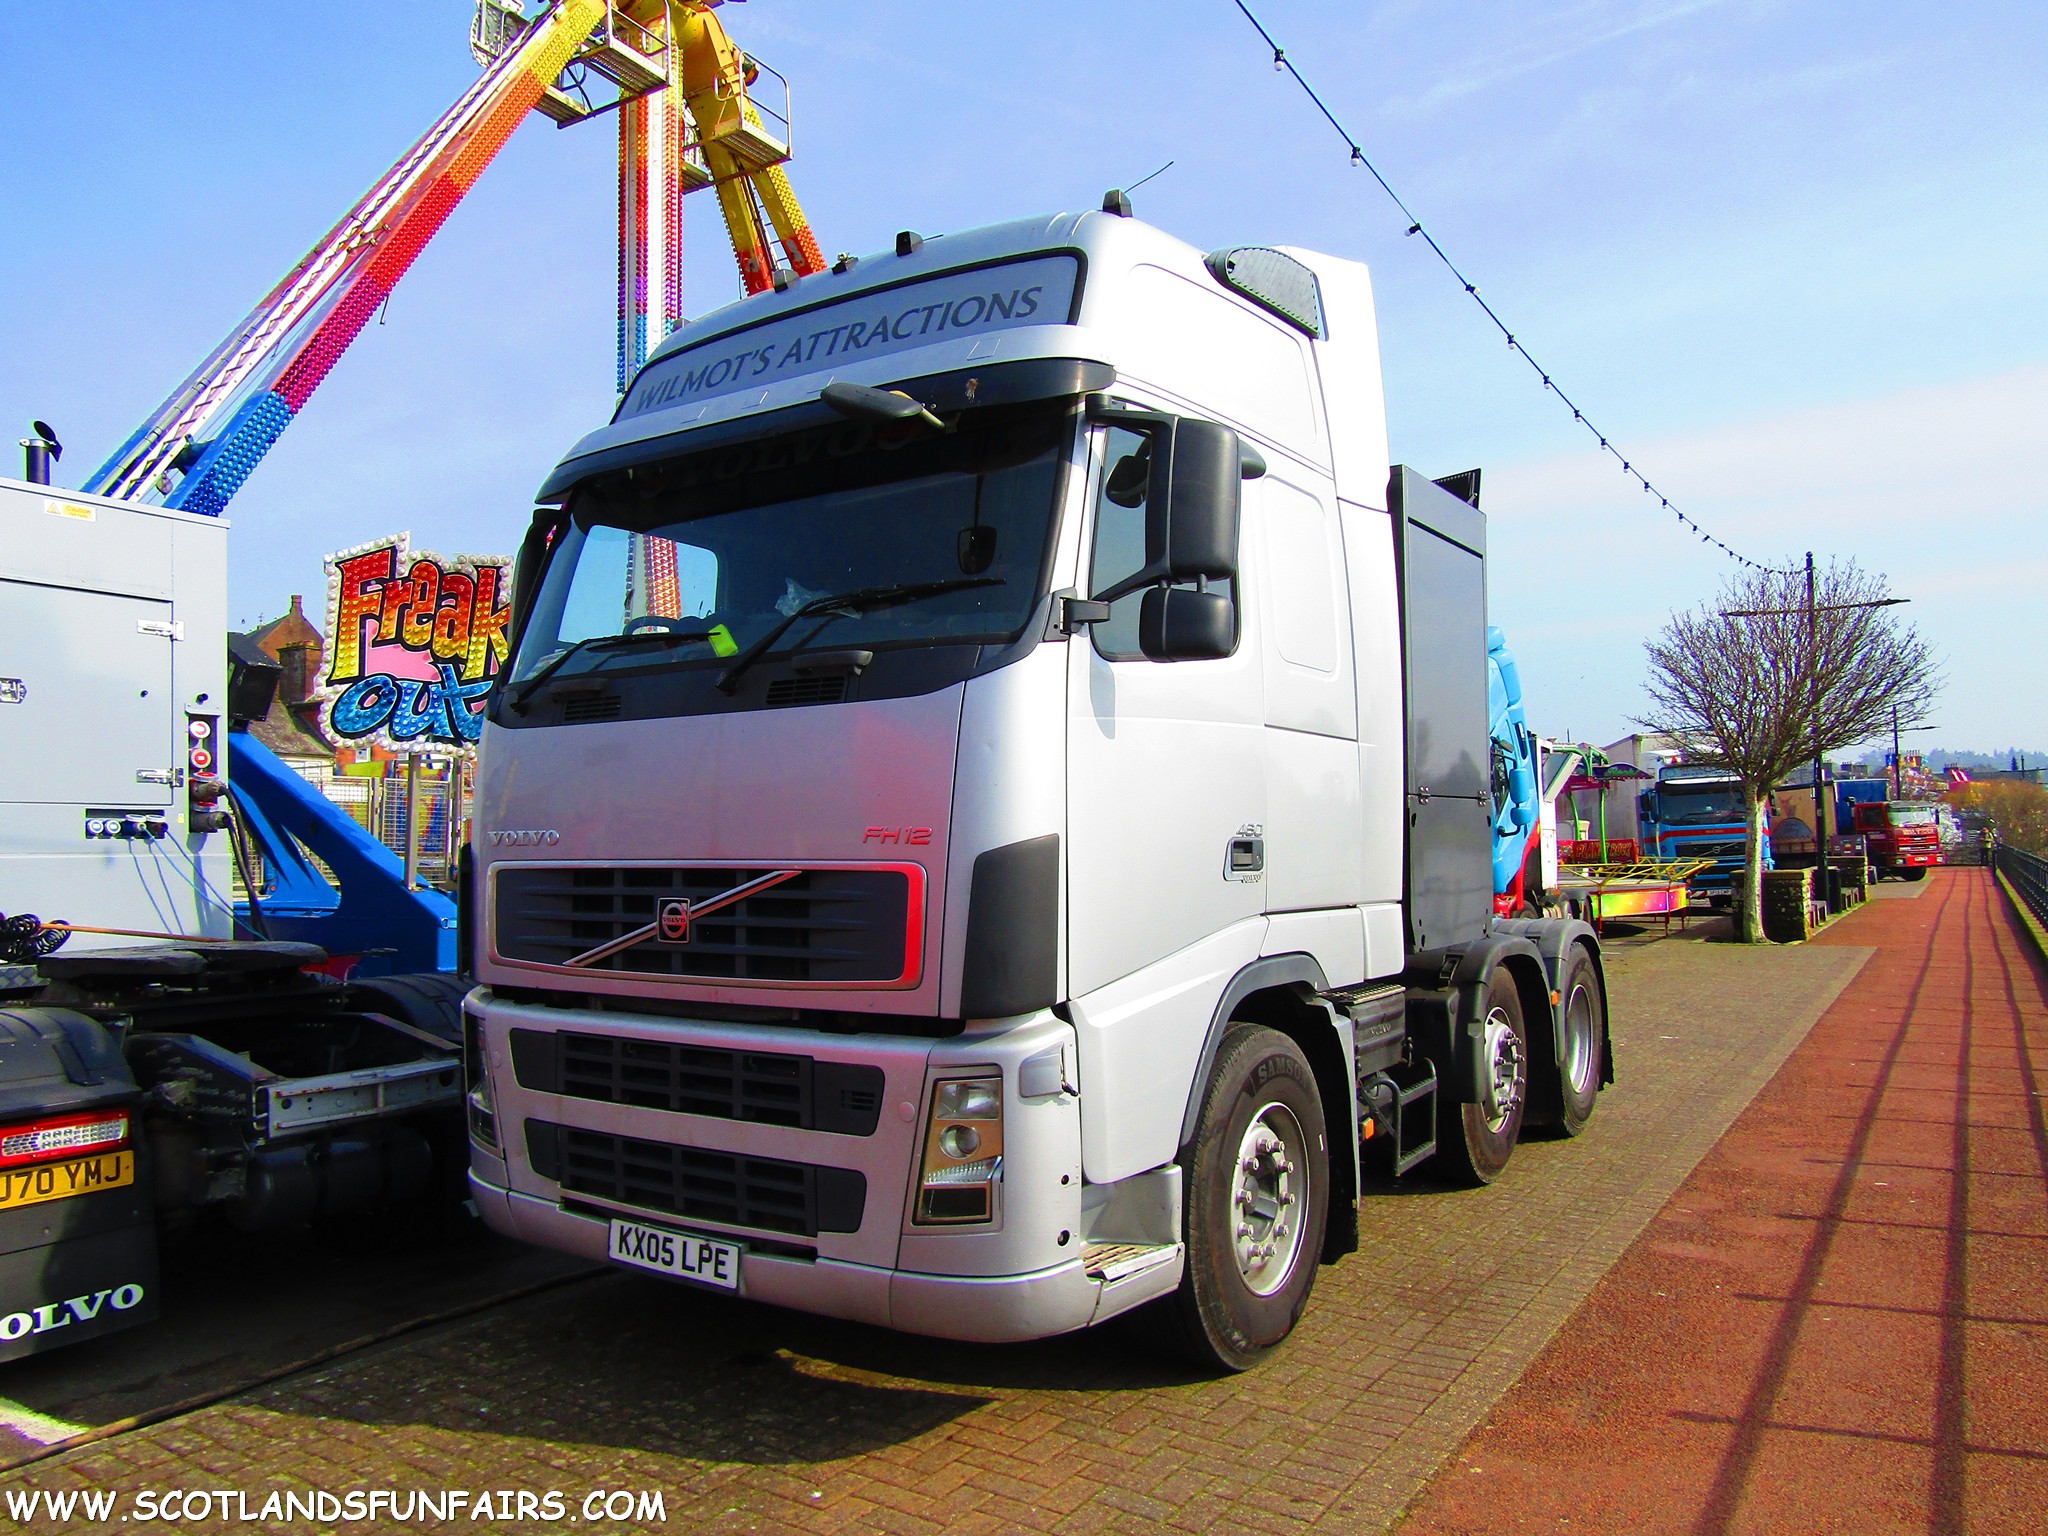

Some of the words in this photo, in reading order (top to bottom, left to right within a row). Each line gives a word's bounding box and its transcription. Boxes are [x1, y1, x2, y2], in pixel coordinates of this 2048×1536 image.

[635, 344, 776, 413] WILMOT'S
[776, 286, 1043, 369] ATTRACTIONS
[330, 547, 511, 683] Freak
[487, 829, 561, 847] VOLVO
[1576, 842, 1610, 859] PLANT
[1241, 874, 1262, 884] VOLVO
[662, 915, 686, 924] VOLVO
[65, 1155, 121, 1190] YMJ
[618, 1224, 675, 1267] KX05
[681, 1240, 730, 1280] LPE
